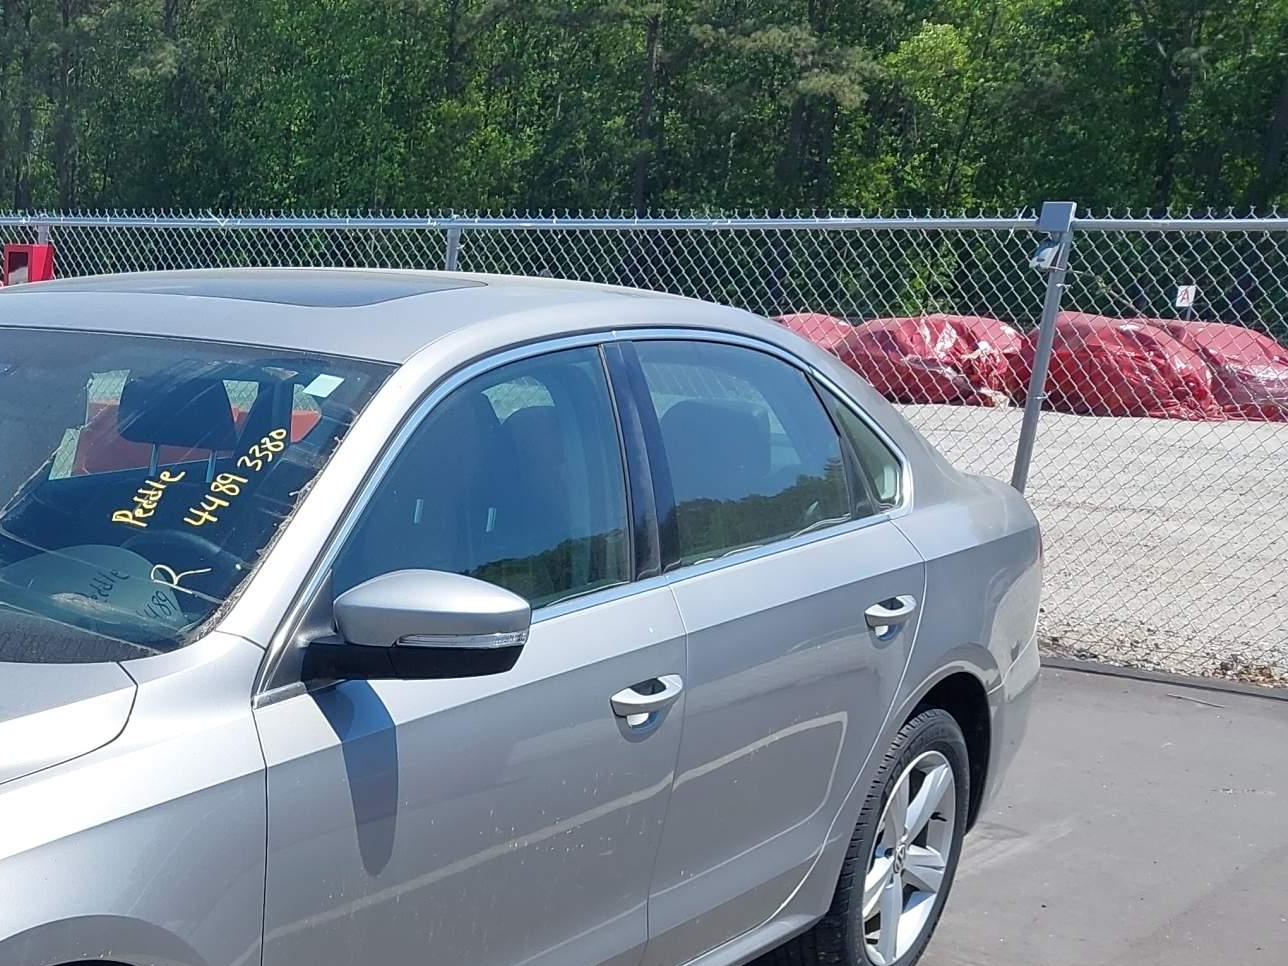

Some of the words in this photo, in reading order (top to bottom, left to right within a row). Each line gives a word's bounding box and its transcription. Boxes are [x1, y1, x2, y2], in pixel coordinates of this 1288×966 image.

[112, 470, 185, 527] Peddle
[184, 473, 249, 526] 4489
[237, 428, 288, 472] 3380
[150, 563, 212, 595] R
